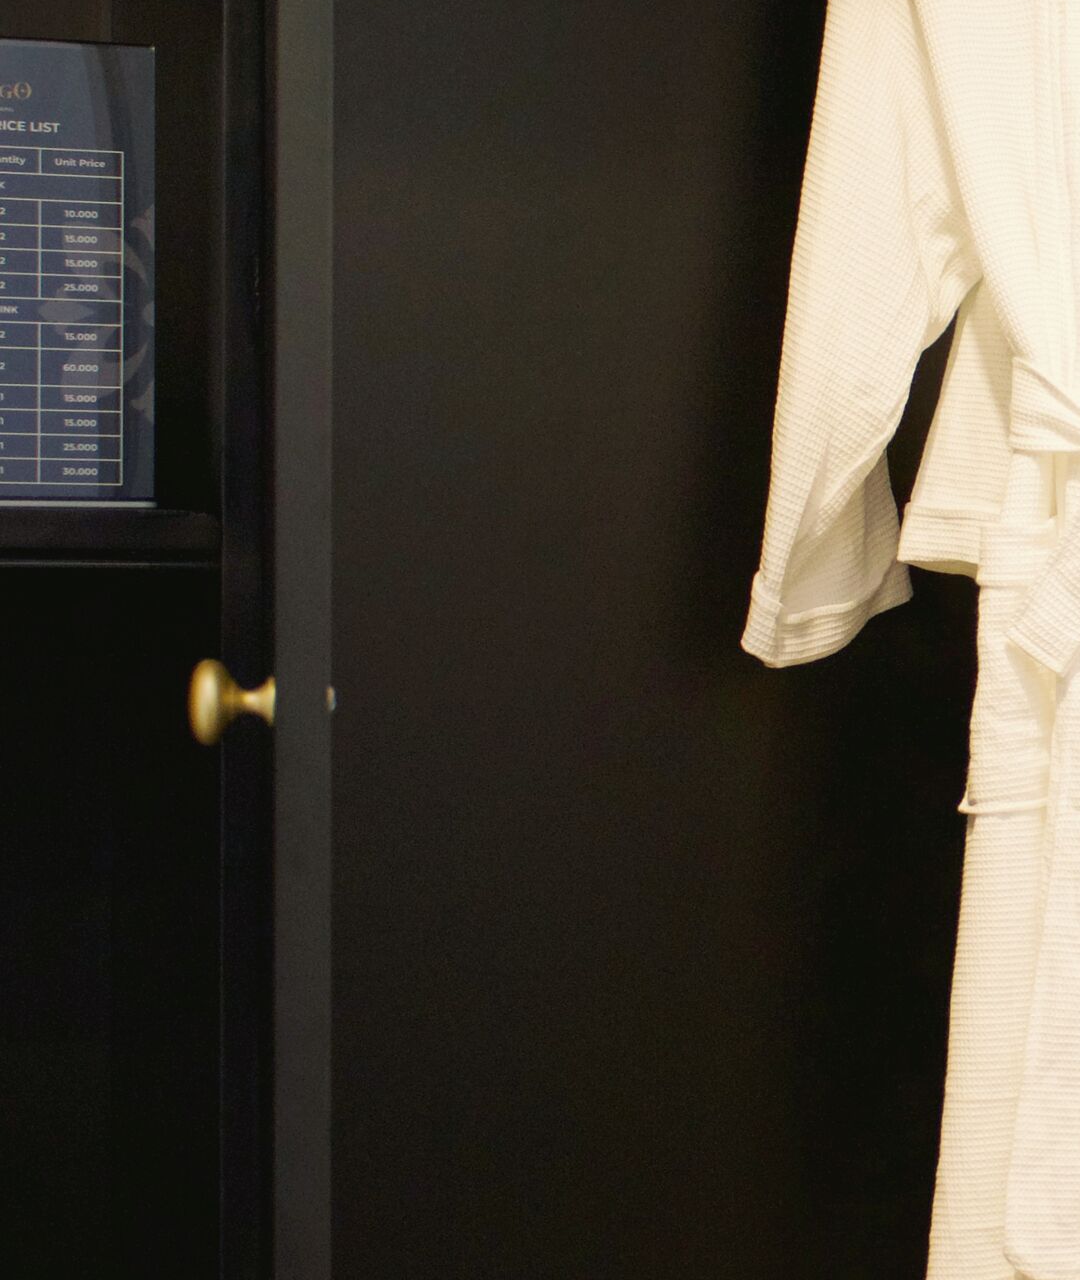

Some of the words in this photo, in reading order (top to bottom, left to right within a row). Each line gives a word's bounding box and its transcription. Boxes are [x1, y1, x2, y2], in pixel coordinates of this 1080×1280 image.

[30, 122, 61, 134] LIST
[54, 157, 77, 167] Unit
[79, 158, 107, 168] Price
[64, 209, 98, 219] 10.000
[64, 234, 98, 244] 15.000
[64, 259, 98, 268] 15.000
[63, 283, 98, 292] 25.000
[64, 332, 98, 341] 15.000
[63, 363, 99, 372] 60.000
[64, 394, 97, 403] 15.000
[64, 419, 97, 427] 15.000
[63, 443, 98, 451] 25.000
[62, 467, 98, 476] 30.000
